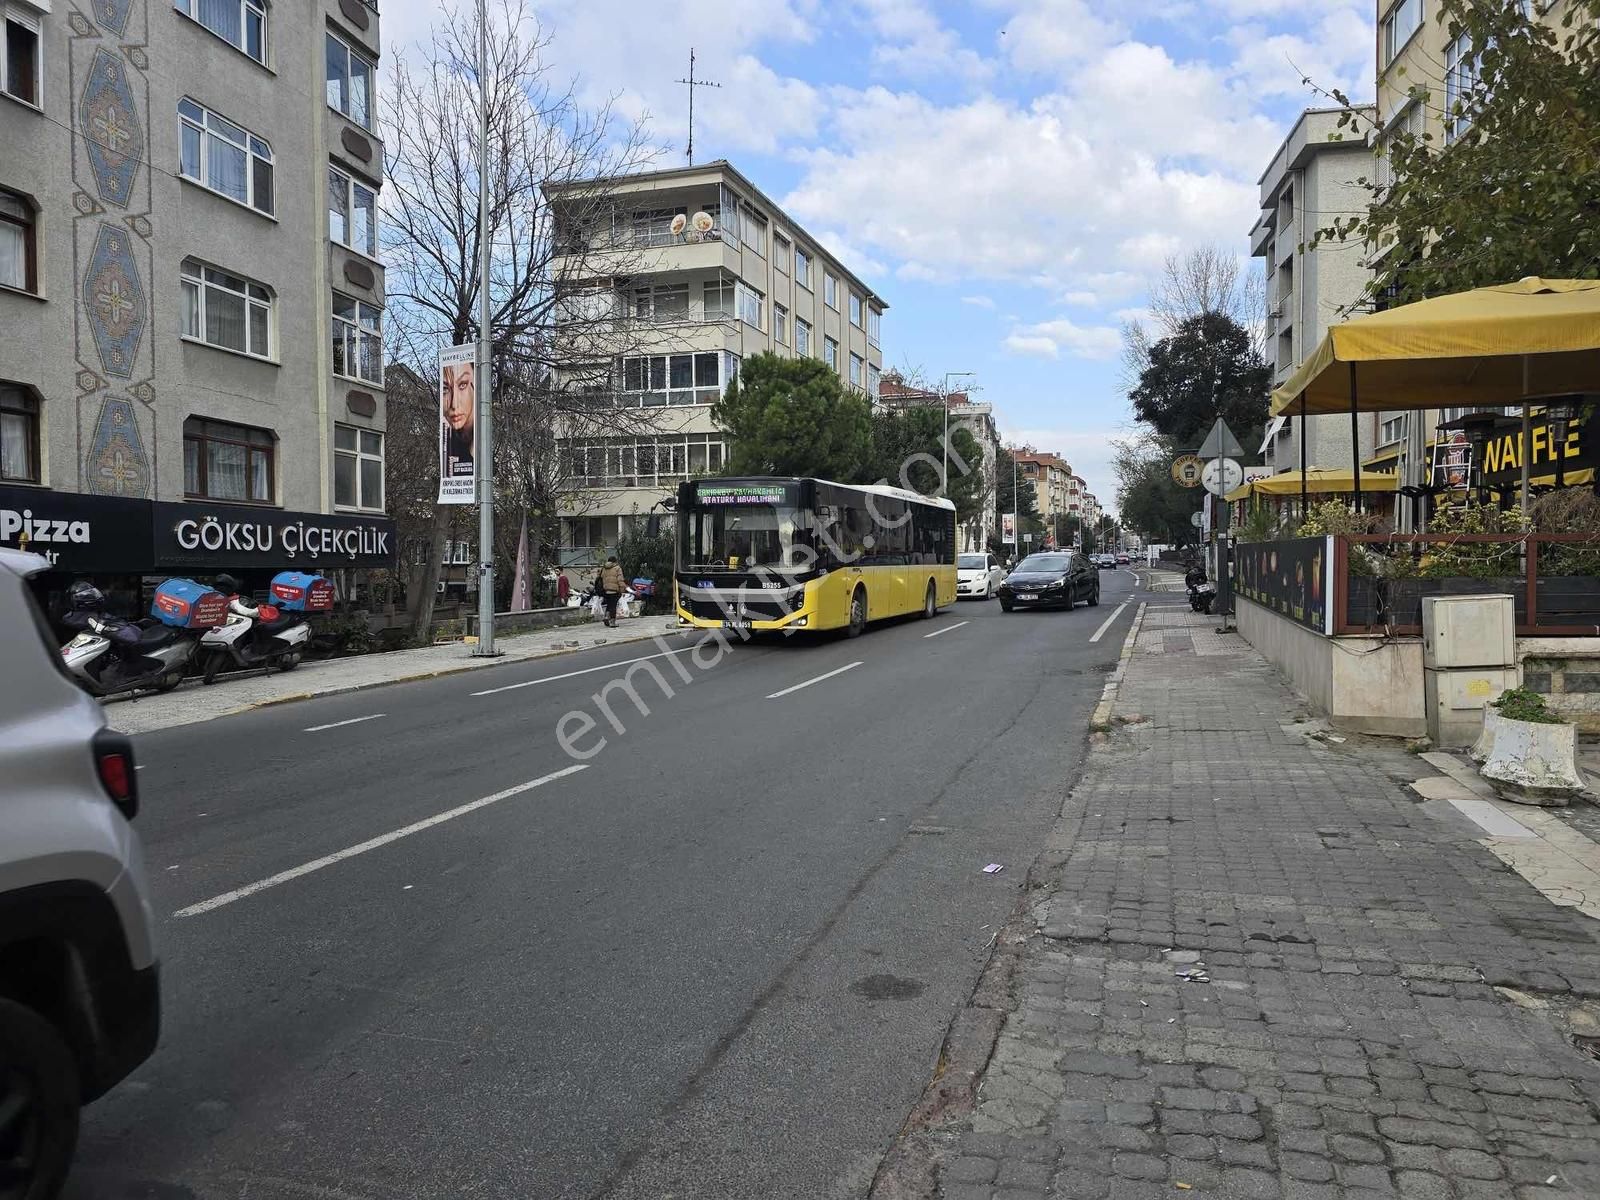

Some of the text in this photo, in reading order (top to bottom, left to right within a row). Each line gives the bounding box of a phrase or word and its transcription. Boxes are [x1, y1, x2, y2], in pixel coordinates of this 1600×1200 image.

[0, 509, 90, 543] Pizza
[177, 516, 389, 560] GÖKSU ÇİÇEKÇİLİK
